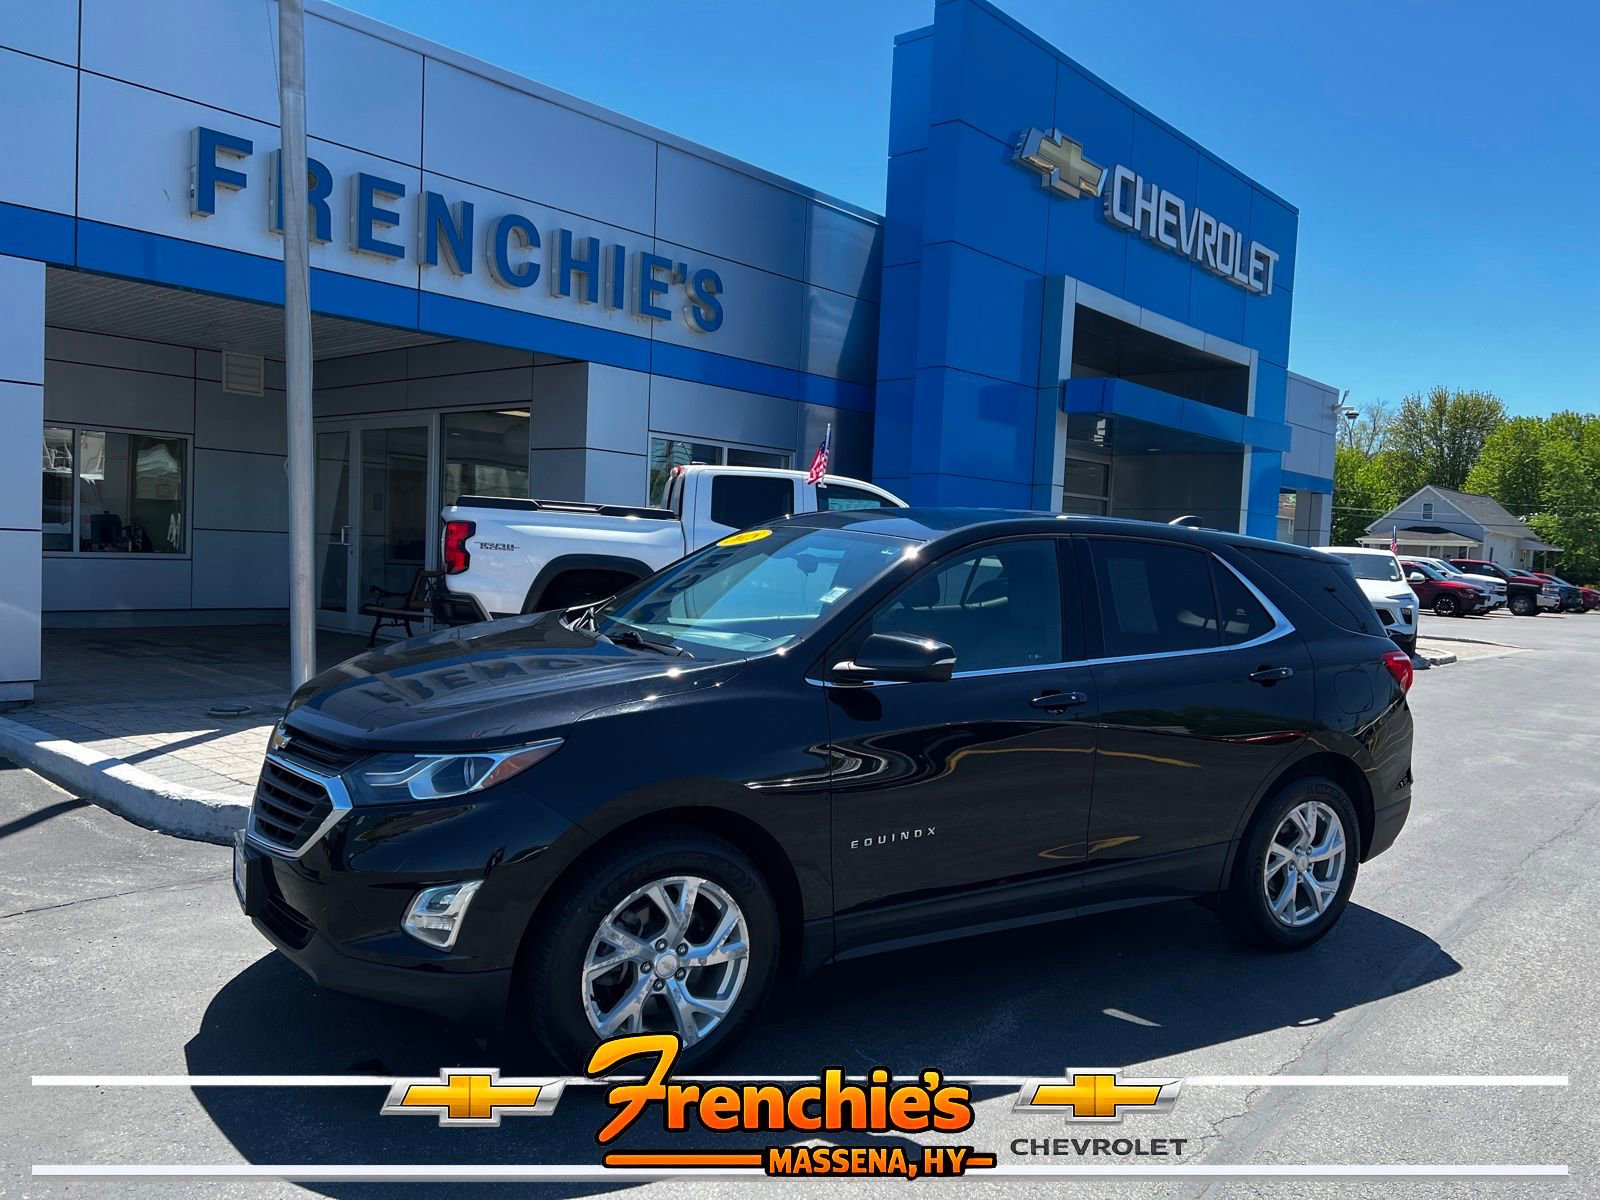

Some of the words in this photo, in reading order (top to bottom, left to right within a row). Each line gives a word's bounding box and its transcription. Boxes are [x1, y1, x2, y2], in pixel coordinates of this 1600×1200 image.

[189, 126, 724, 333] FRENCHIE'S
[1104, 164, 1280, 296] CHEVROLET
[850, 826, 936, 849] EQUINOX
